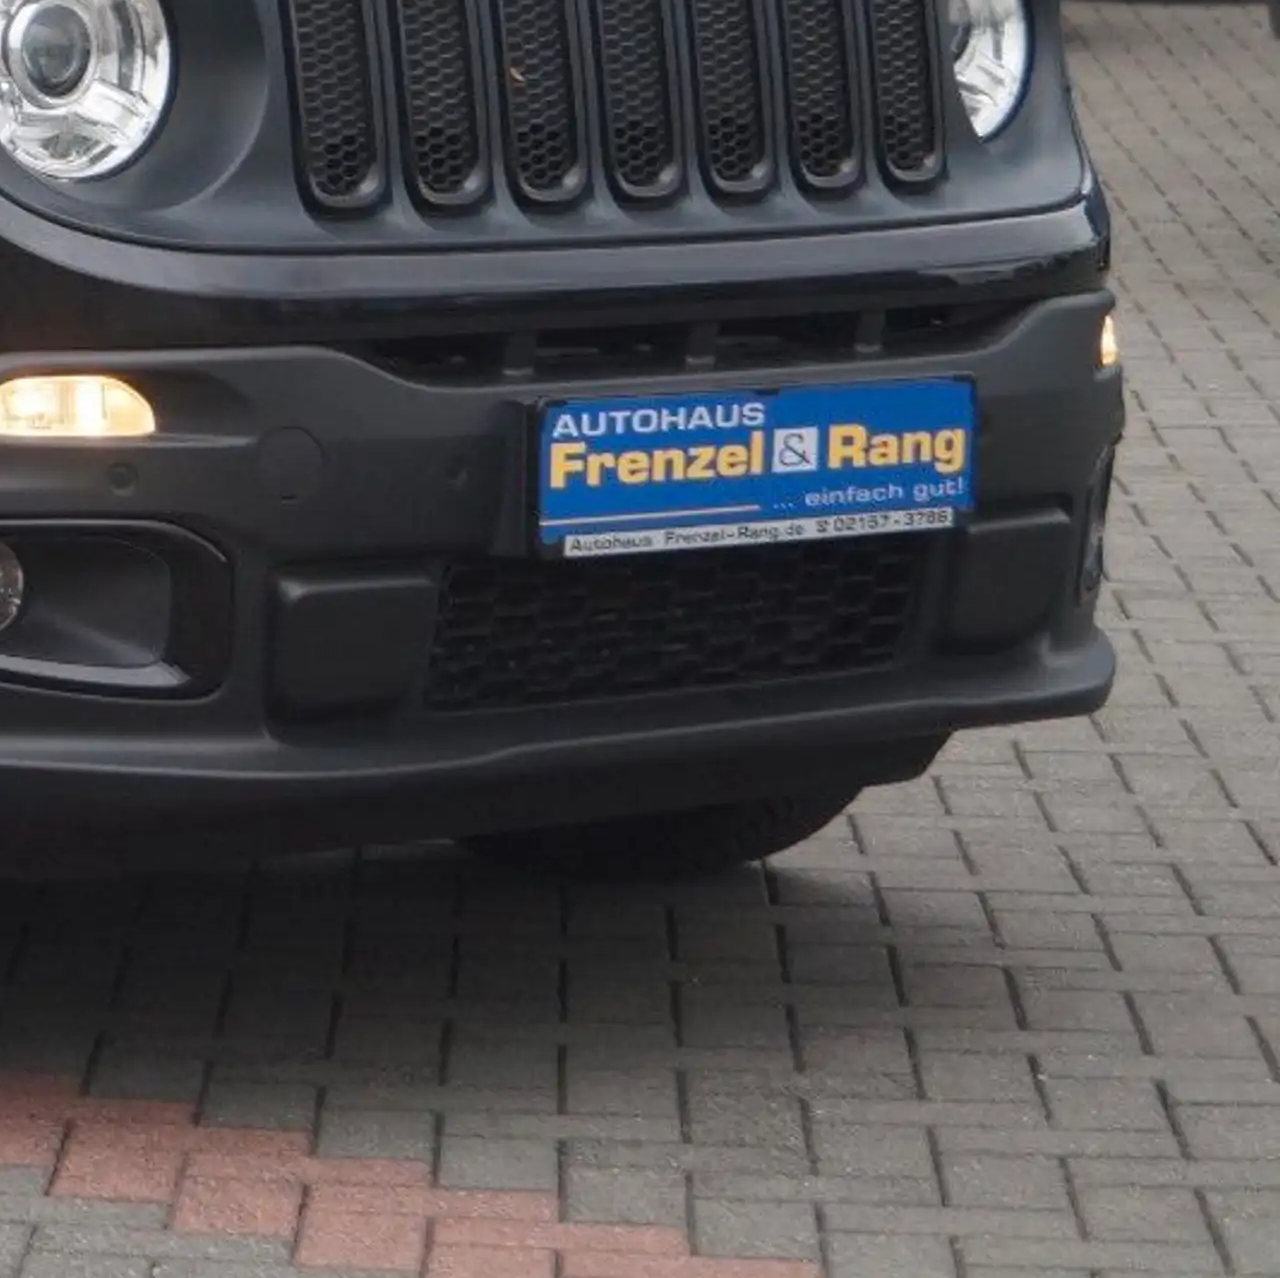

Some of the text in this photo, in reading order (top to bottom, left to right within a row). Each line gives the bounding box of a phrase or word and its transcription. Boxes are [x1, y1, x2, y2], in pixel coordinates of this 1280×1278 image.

[552, 401, 766, 439] AUTOHAUS
[549, 423, 966, 490] Frenzel & Rang
[804, 483, 904, 509] einfach
[912, 476, 966, 502] gut!
[569, 533, 653, 553] Autohaus
